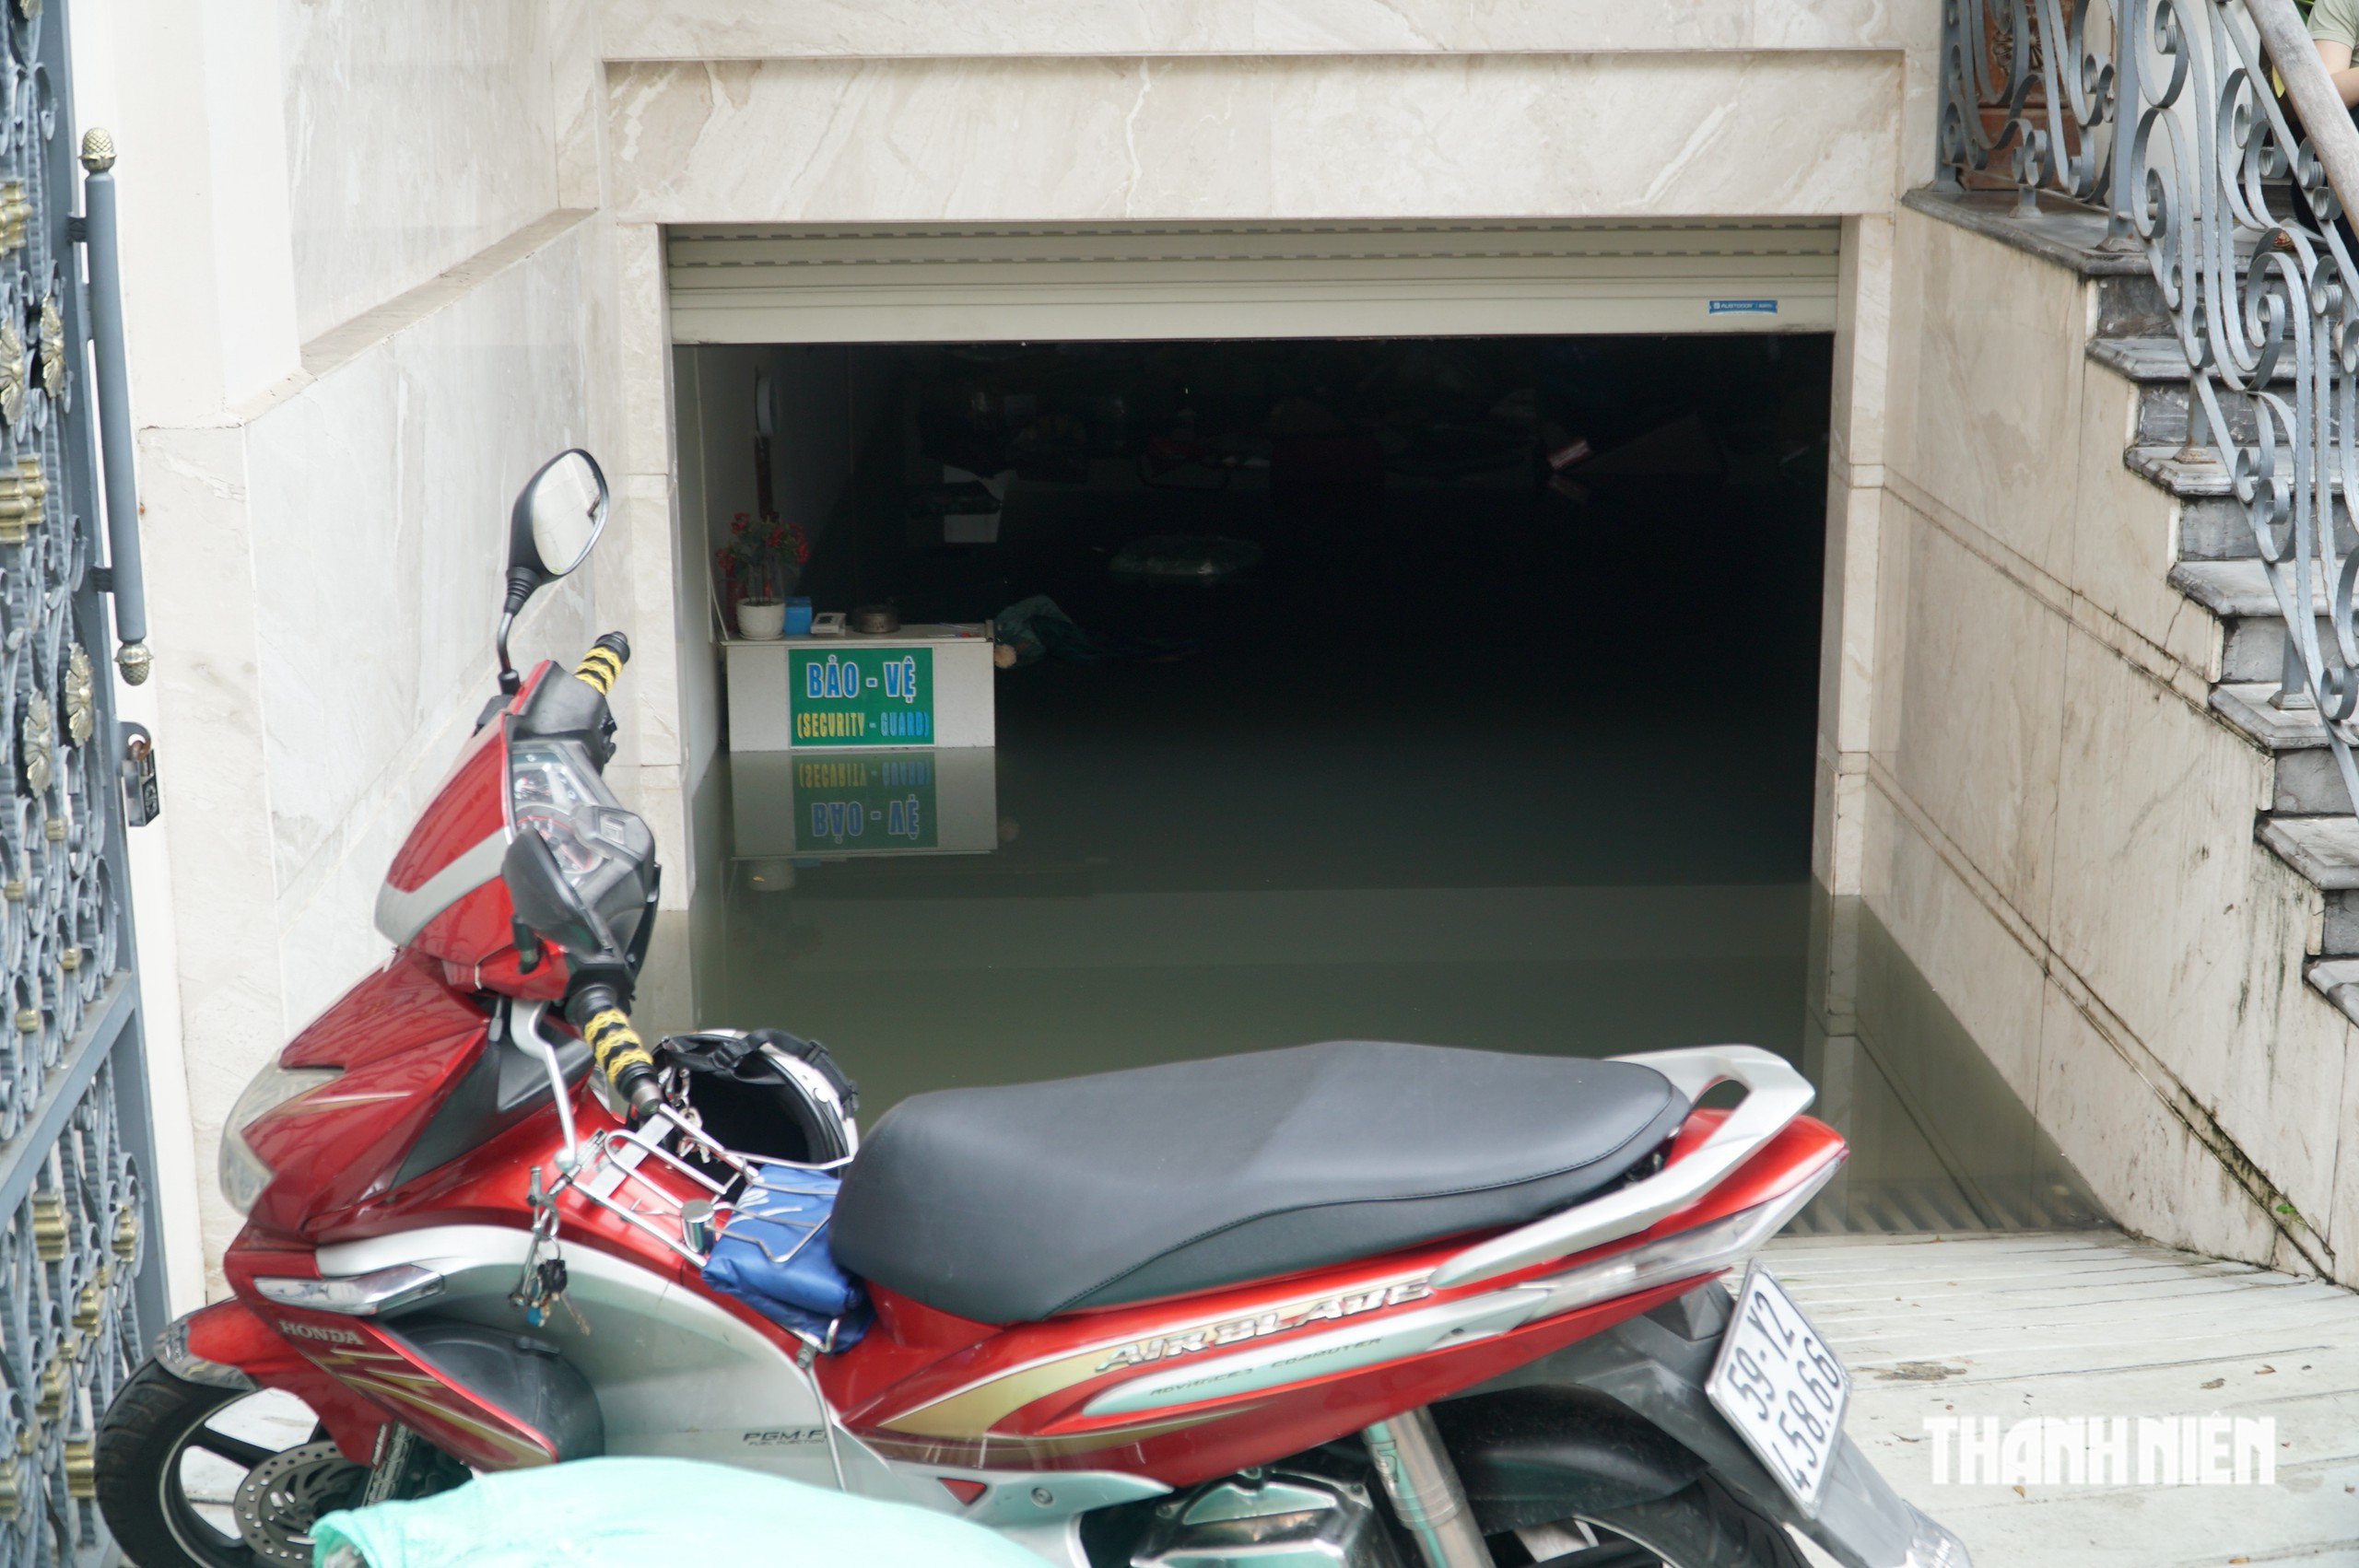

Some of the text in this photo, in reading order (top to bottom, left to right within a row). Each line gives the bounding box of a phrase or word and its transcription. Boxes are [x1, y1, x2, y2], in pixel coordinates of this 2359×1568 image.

[806, 654, 860, 698] BẢO
[883, 655, 917, 704] VỆ
[796, 711, 865, 739] (SECURITY
[880, 710, 929, 738] GUARD)
[278, 1319, 365, 1346] HONDA
[1095, 1277, 1434, 1373] AIR BLADE
[1726, 1290, 1796, 1422] 59-Y2
[1771, 1336, 1840, 1491] 458.66
